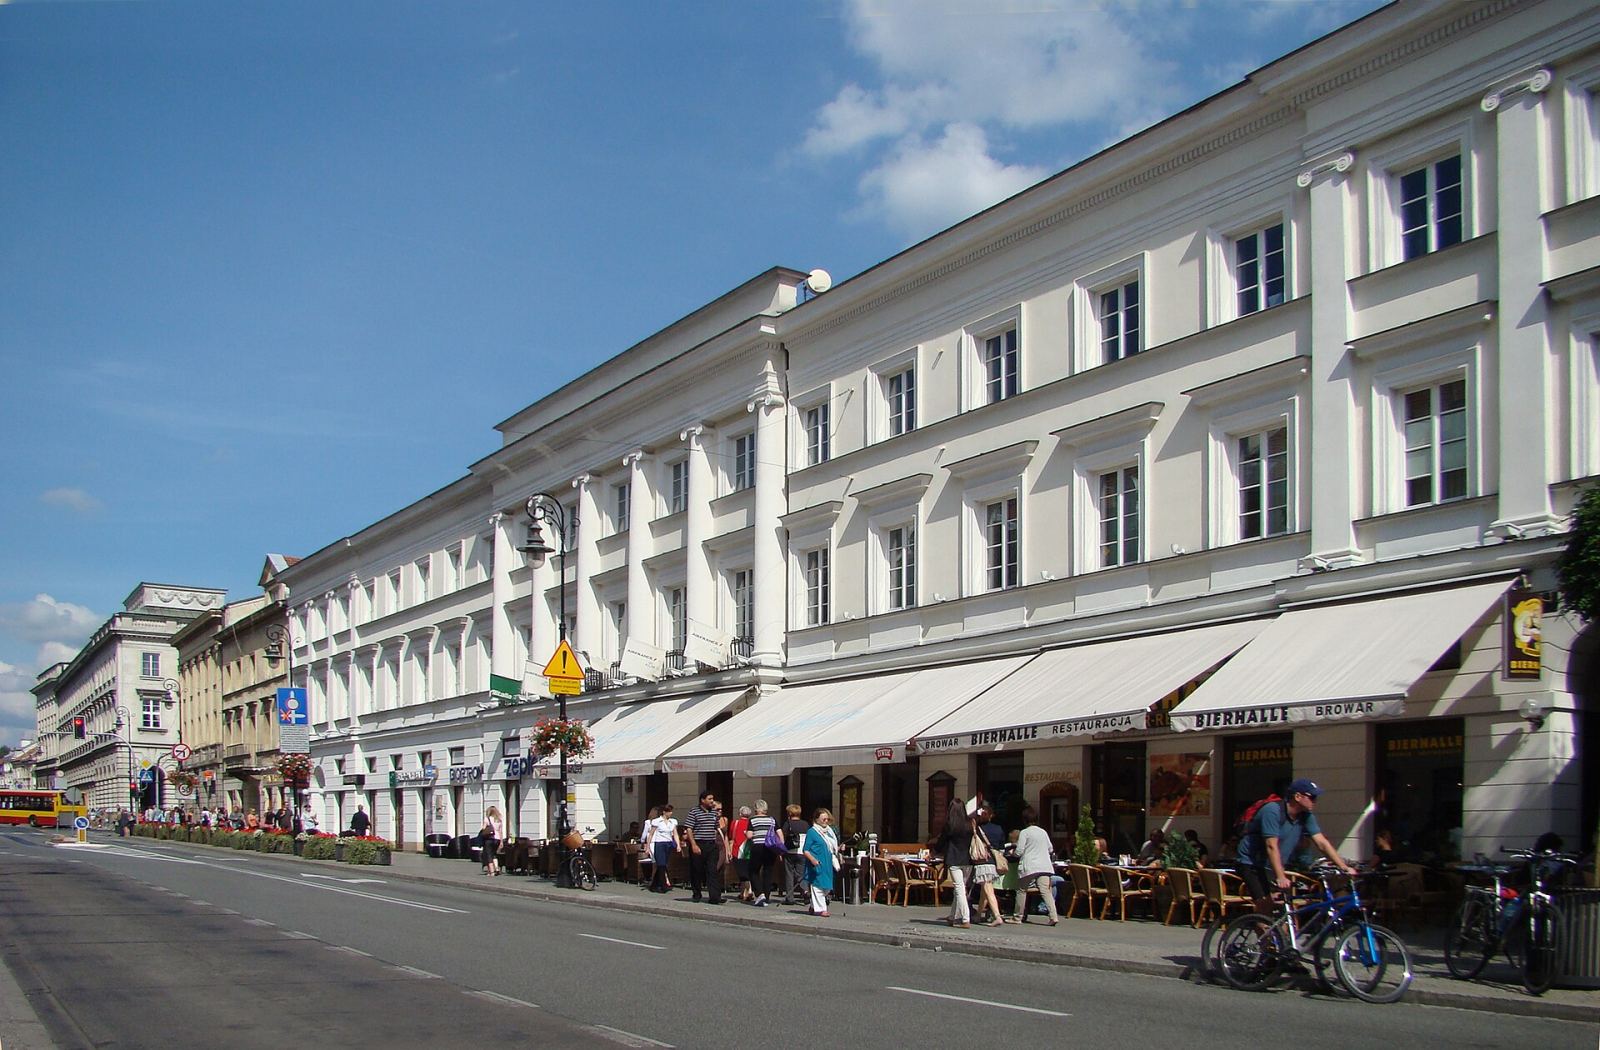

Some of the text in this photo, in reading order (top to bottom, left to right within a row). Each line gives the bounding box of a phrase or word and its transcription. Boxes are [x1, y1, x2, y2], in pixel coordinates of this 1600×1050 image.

[1195, 702, 1374, 728] BIERHALLE BROWAR
[925, 738, 959, 750] BROWAR
[970, 726, 1038, 746] BIERHALLE
[1052, 716, 1132, 735] RESTAURACJA
